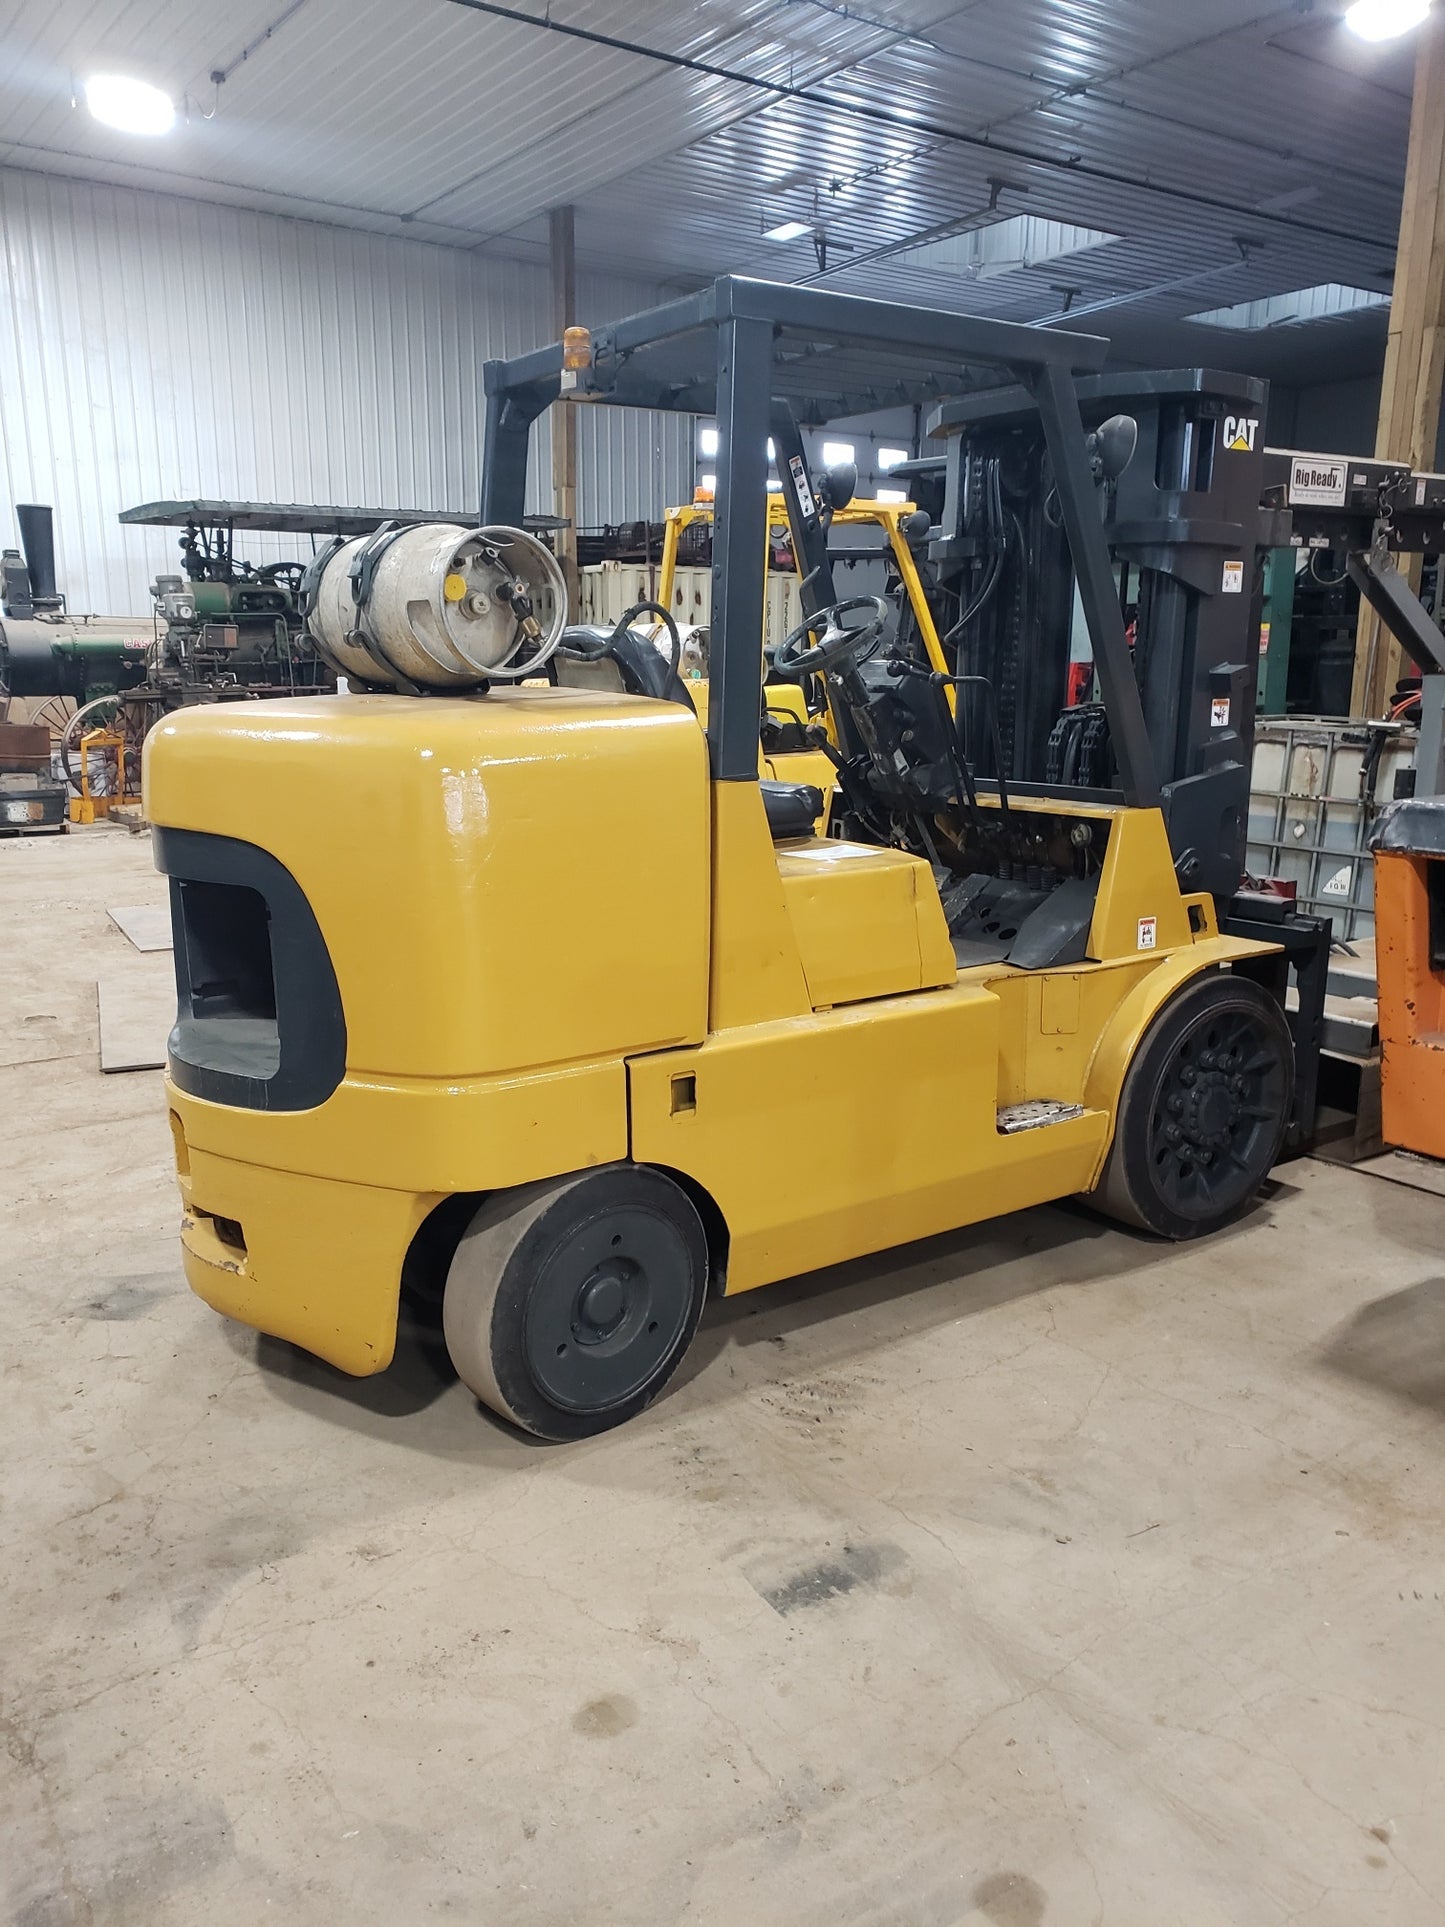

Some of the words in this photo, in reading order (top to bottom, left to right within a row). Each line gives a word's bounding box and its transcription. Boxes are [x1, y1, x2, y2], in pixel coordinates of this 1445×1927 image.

[1223, 416, 1259, 452] CAT
[1295, 469, 1310, 487] Rig
[124, 639, 149, 649] CAS
